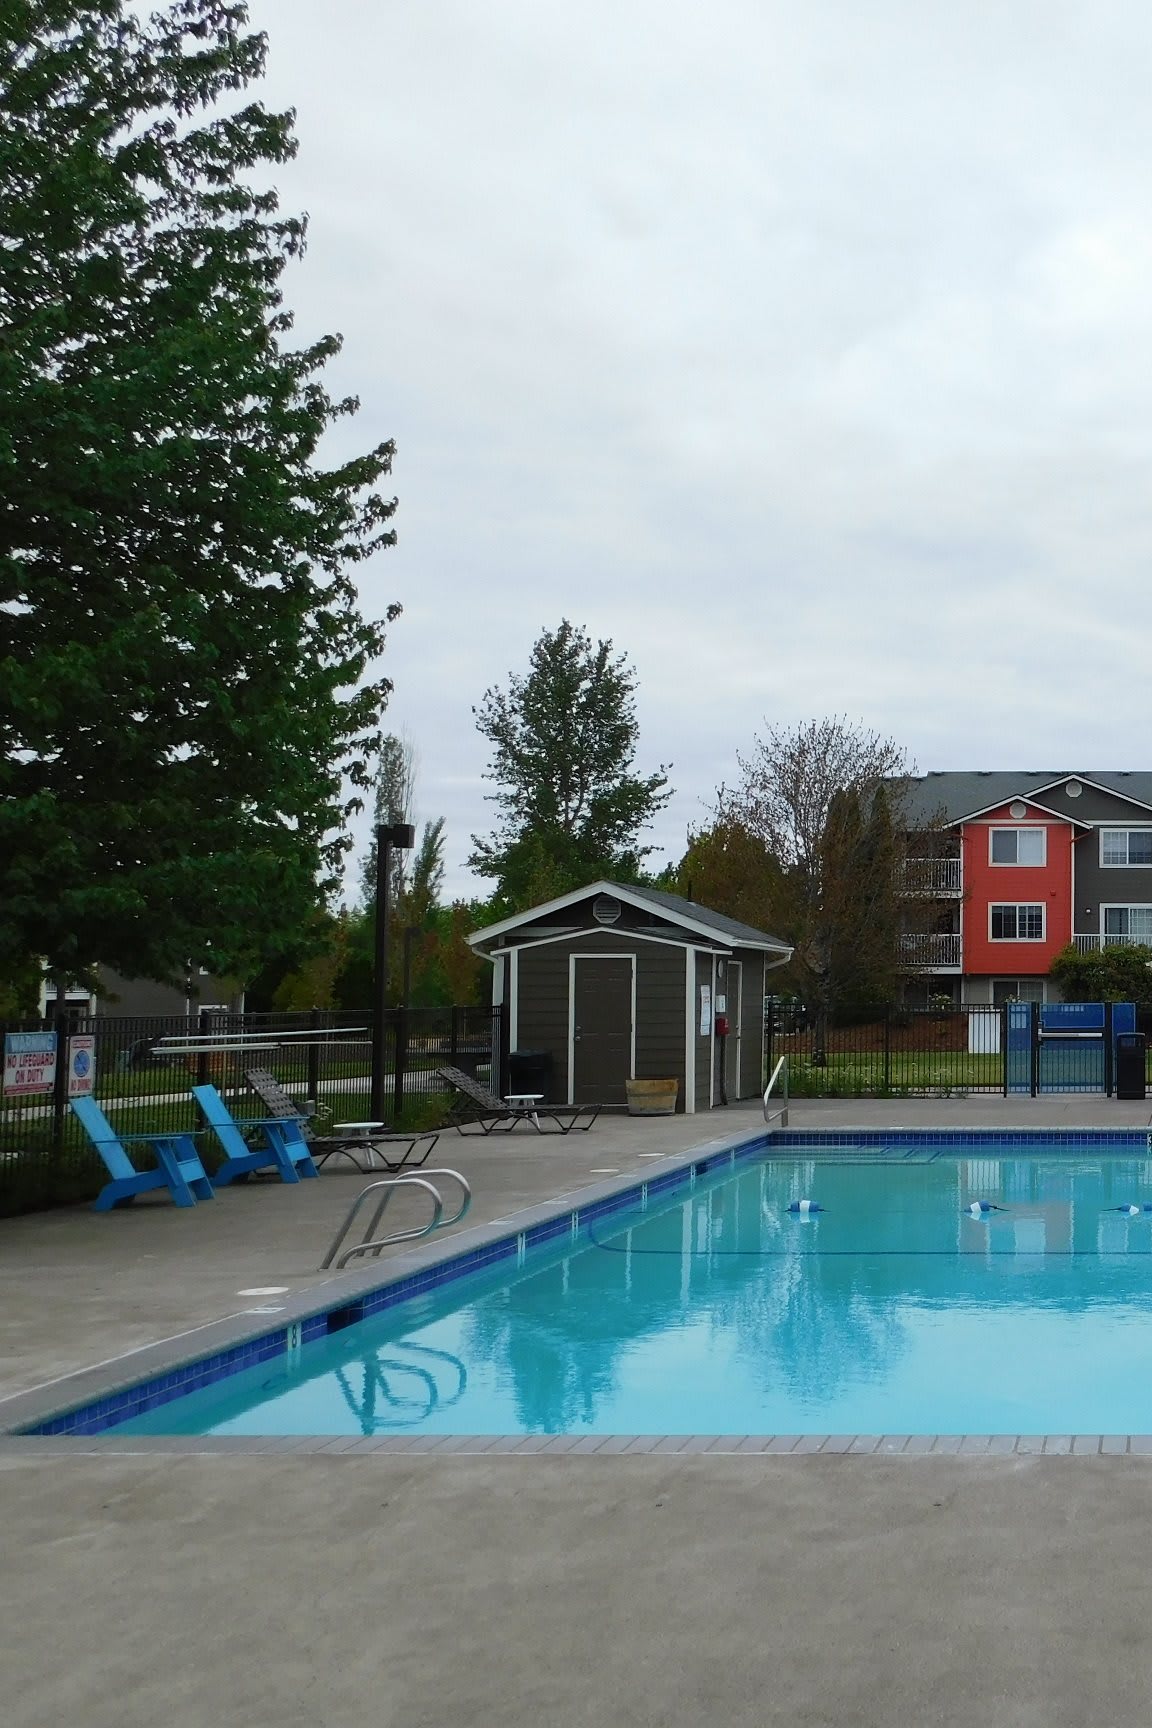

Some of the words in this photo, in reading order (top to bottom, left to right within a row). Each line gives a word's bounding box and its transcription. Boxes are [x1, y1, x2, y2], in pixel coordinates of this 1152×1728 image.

[7, 1055, 17, 1068] NO
[19, 1053, 54, 1067] LIFEGUARD
[15, 1070, 25, 1083] ON
[27, 1068, 44, 1082] DUTY
[292, 1324, 298, 1349] 8
